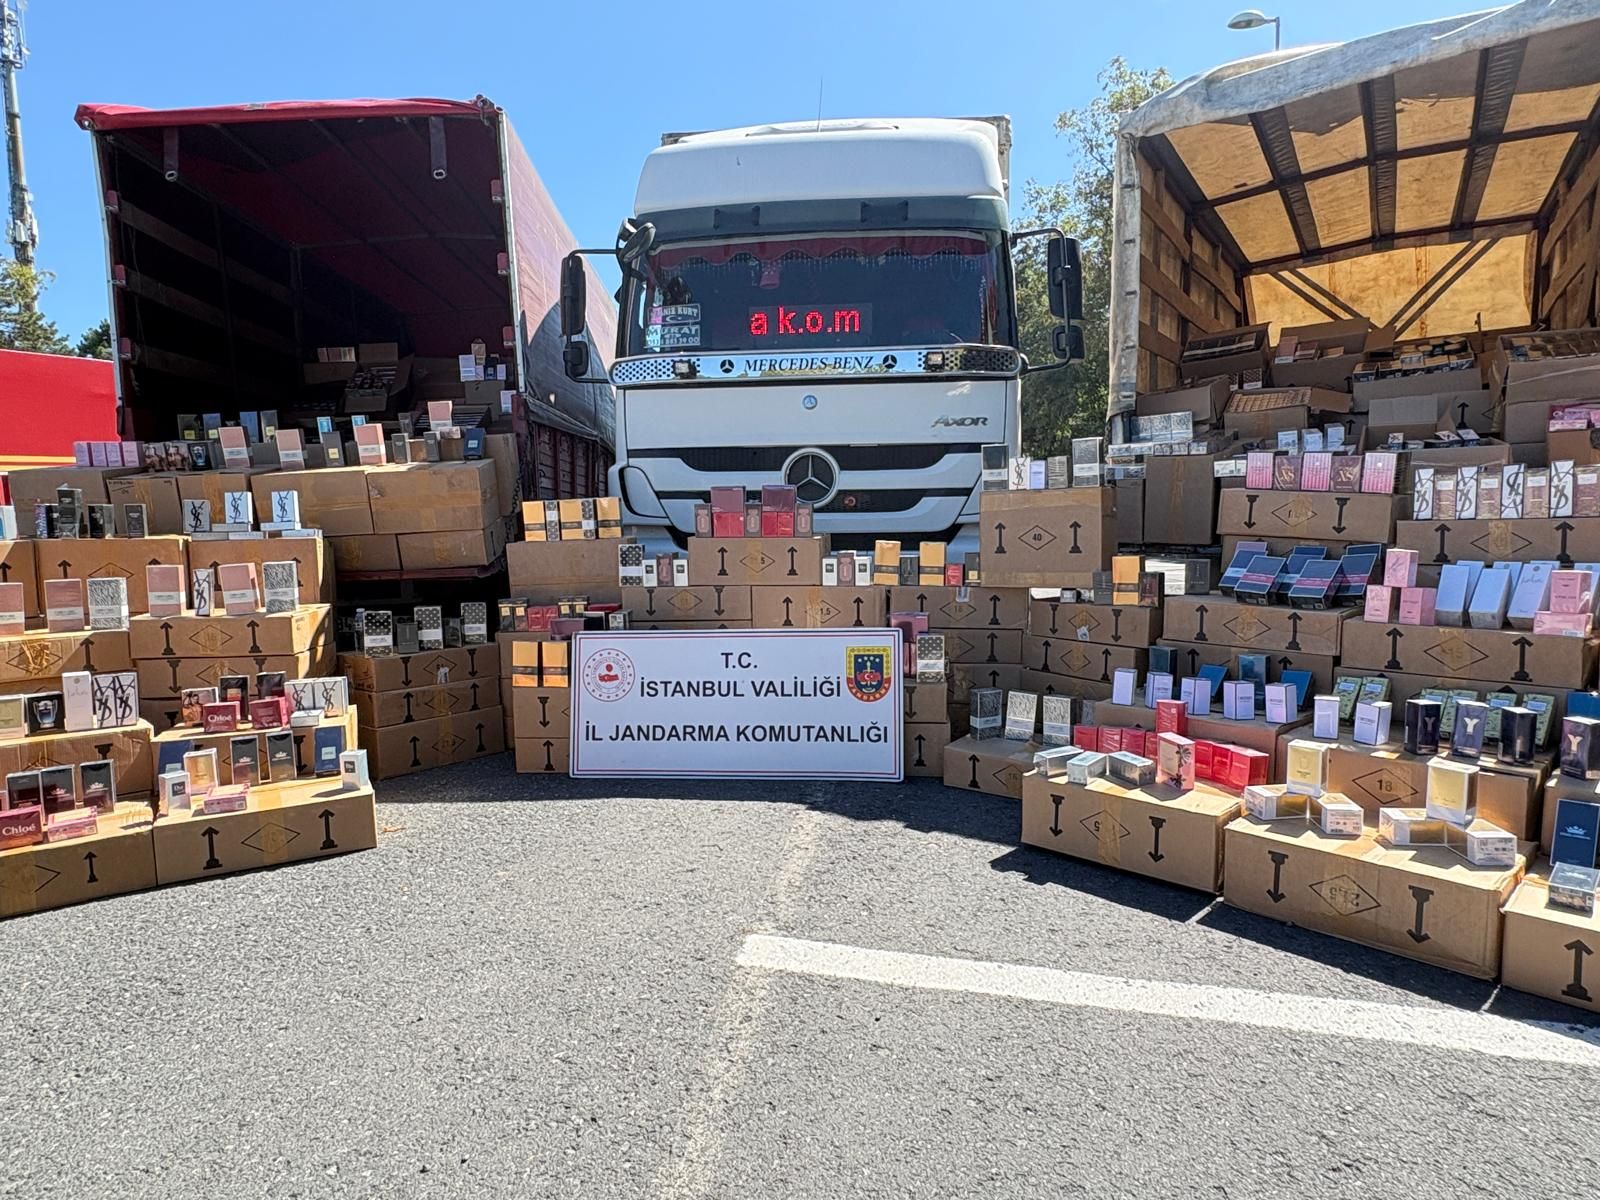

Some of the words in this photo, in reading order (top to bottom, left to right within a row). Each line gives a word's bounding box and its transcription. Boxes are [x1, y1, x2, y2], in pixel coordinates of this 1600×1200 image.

[750, 312, 768, 335] a
[931, 415, 988, 428] AXOR
[1032, 533, 1042, 541] 40
[721, 652, 758, 669] T.C.
[640, 677, 745, 698] İSTANBUL
[751, 675, 841, 698] VALİLİĞİ
[585, 721, 603, 741] İL
[609, 724, 730, 742] JANDARMA
[736, 721, 888, 743] KOMUTANLIĞI
[1463, 717, 1480, 734] Y
[1567, 733, 1583, 752] Y
[2, 823, 36, 836] Chloé
